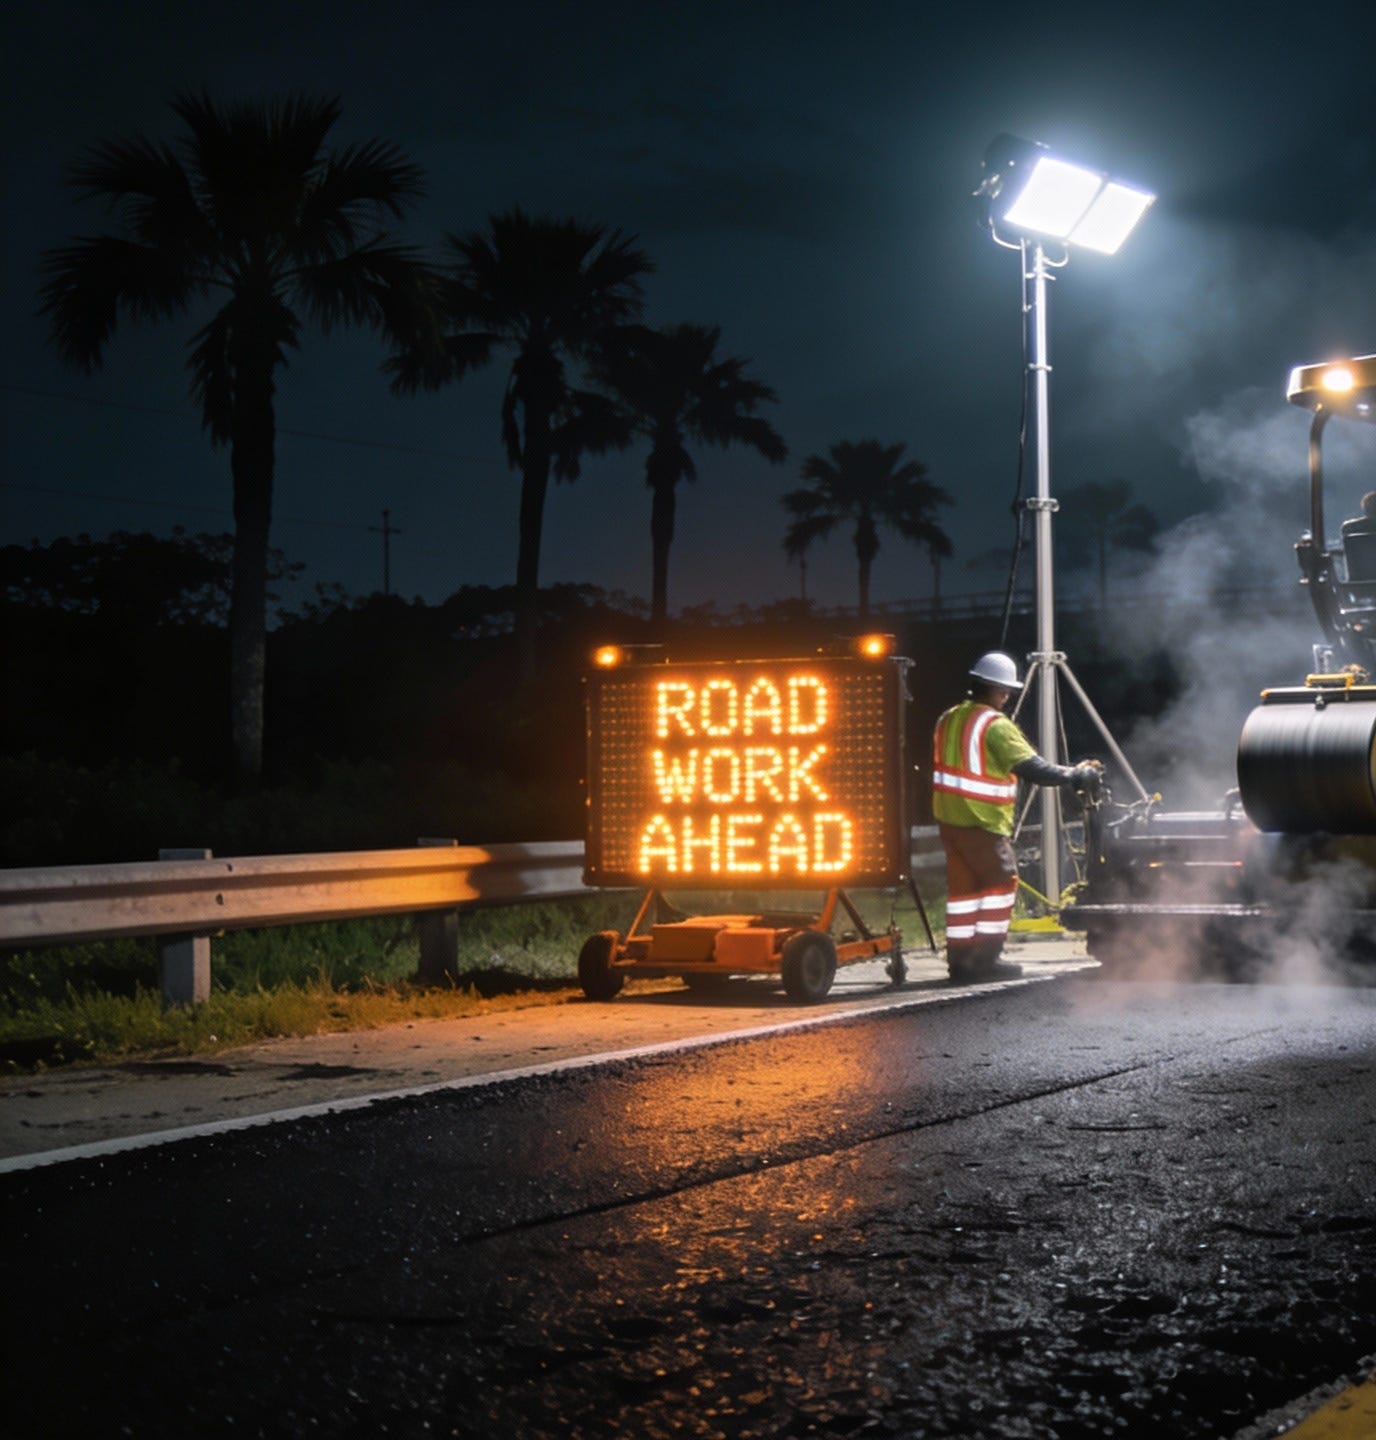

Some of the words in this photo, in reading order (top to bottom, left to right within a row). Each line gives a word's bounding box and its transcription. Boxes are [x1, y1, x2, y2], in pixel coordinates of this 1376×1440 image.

[656, 676, 828, 738] ROAD
[652, 744, 829, 803] WORK
[638, 813, 853, 873] AHEAD
